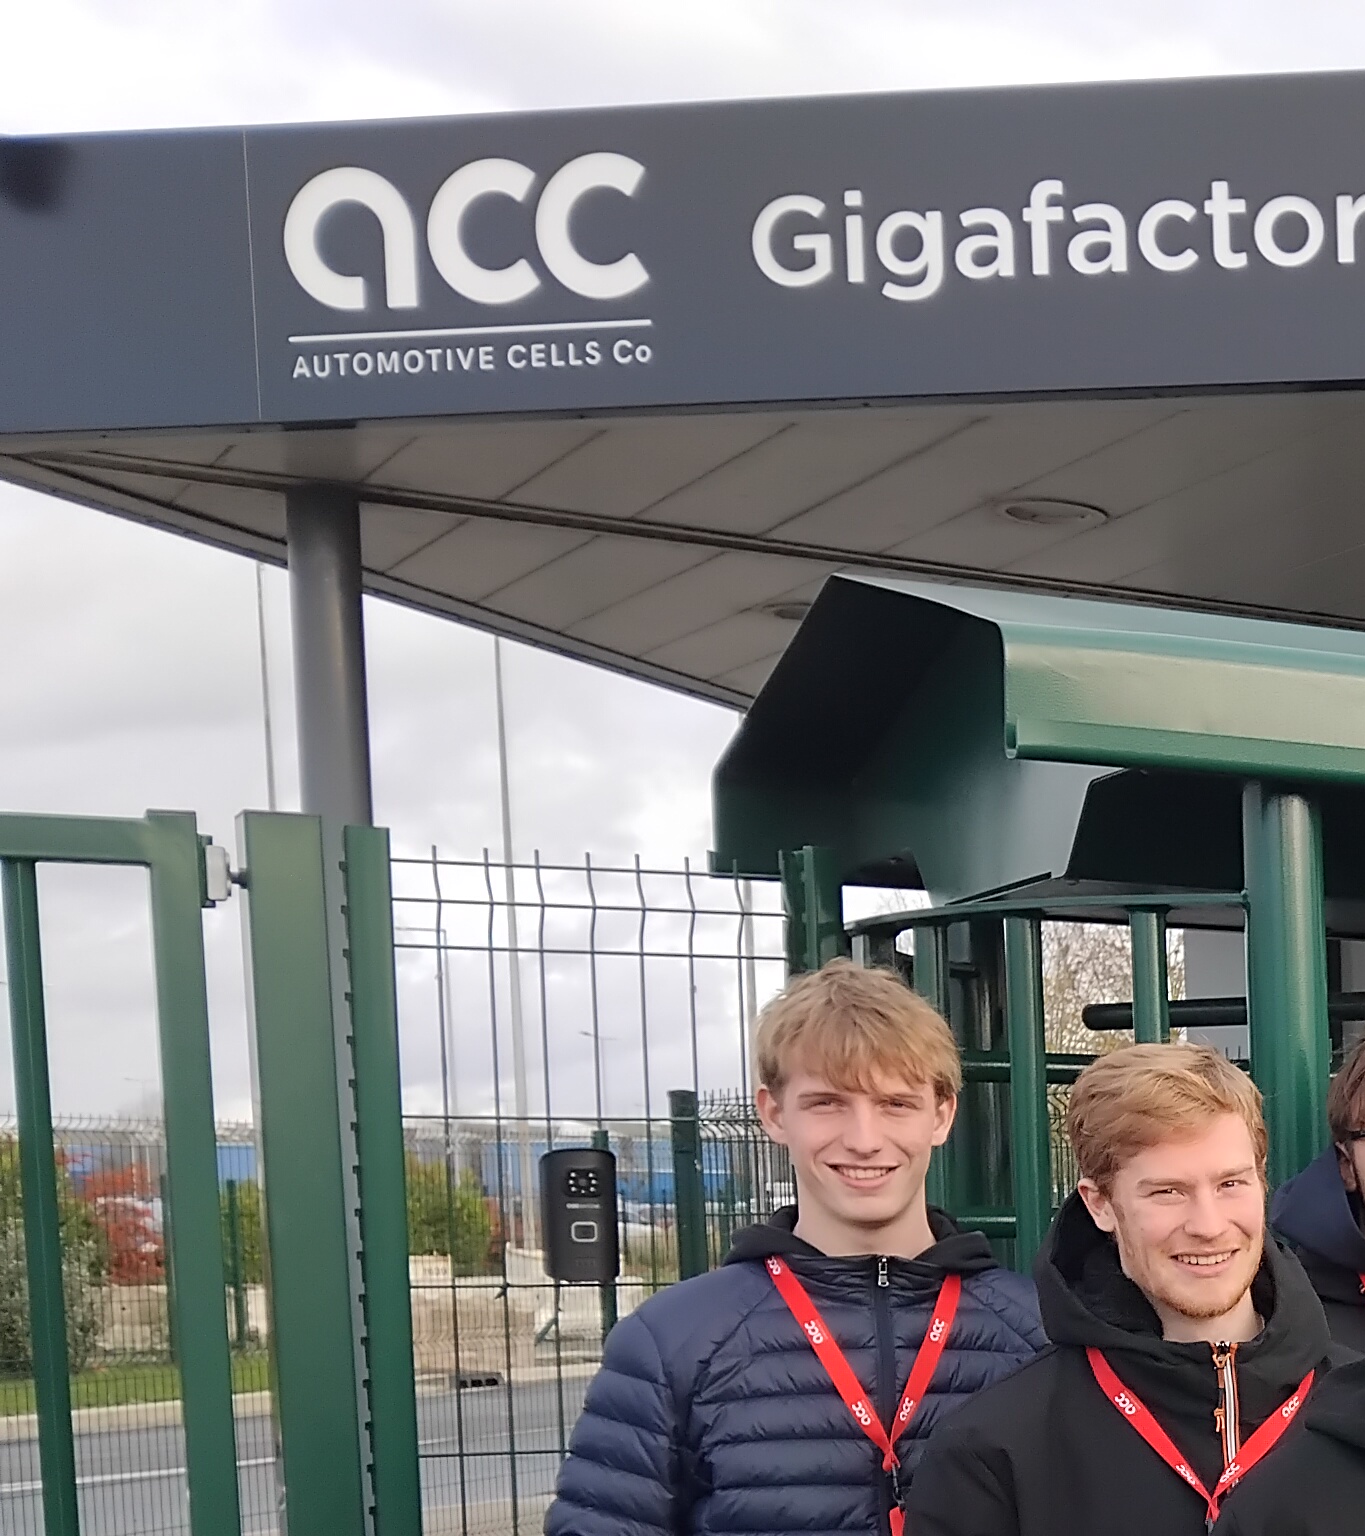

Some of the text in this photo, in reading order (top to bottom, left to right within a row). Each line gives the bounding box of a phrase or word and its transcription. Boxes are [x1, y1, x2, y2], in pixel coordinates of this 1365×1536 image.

[283, 151, 651, 310] acc
[292, 339, 653, 379] AUTOMOTIVE CELLS Co
[804, 1320, 823, 1344] acc
[930, 1319, 944, 1341] acc
[852, 1401, 871, 1425] acc
[900, 1397, 914, 1421] acc
[1114, 1393, 1136, 1414] acc
[1282, 1396, 1300, 1418] acc
[1219, 1463, 1240, 1484] acc
